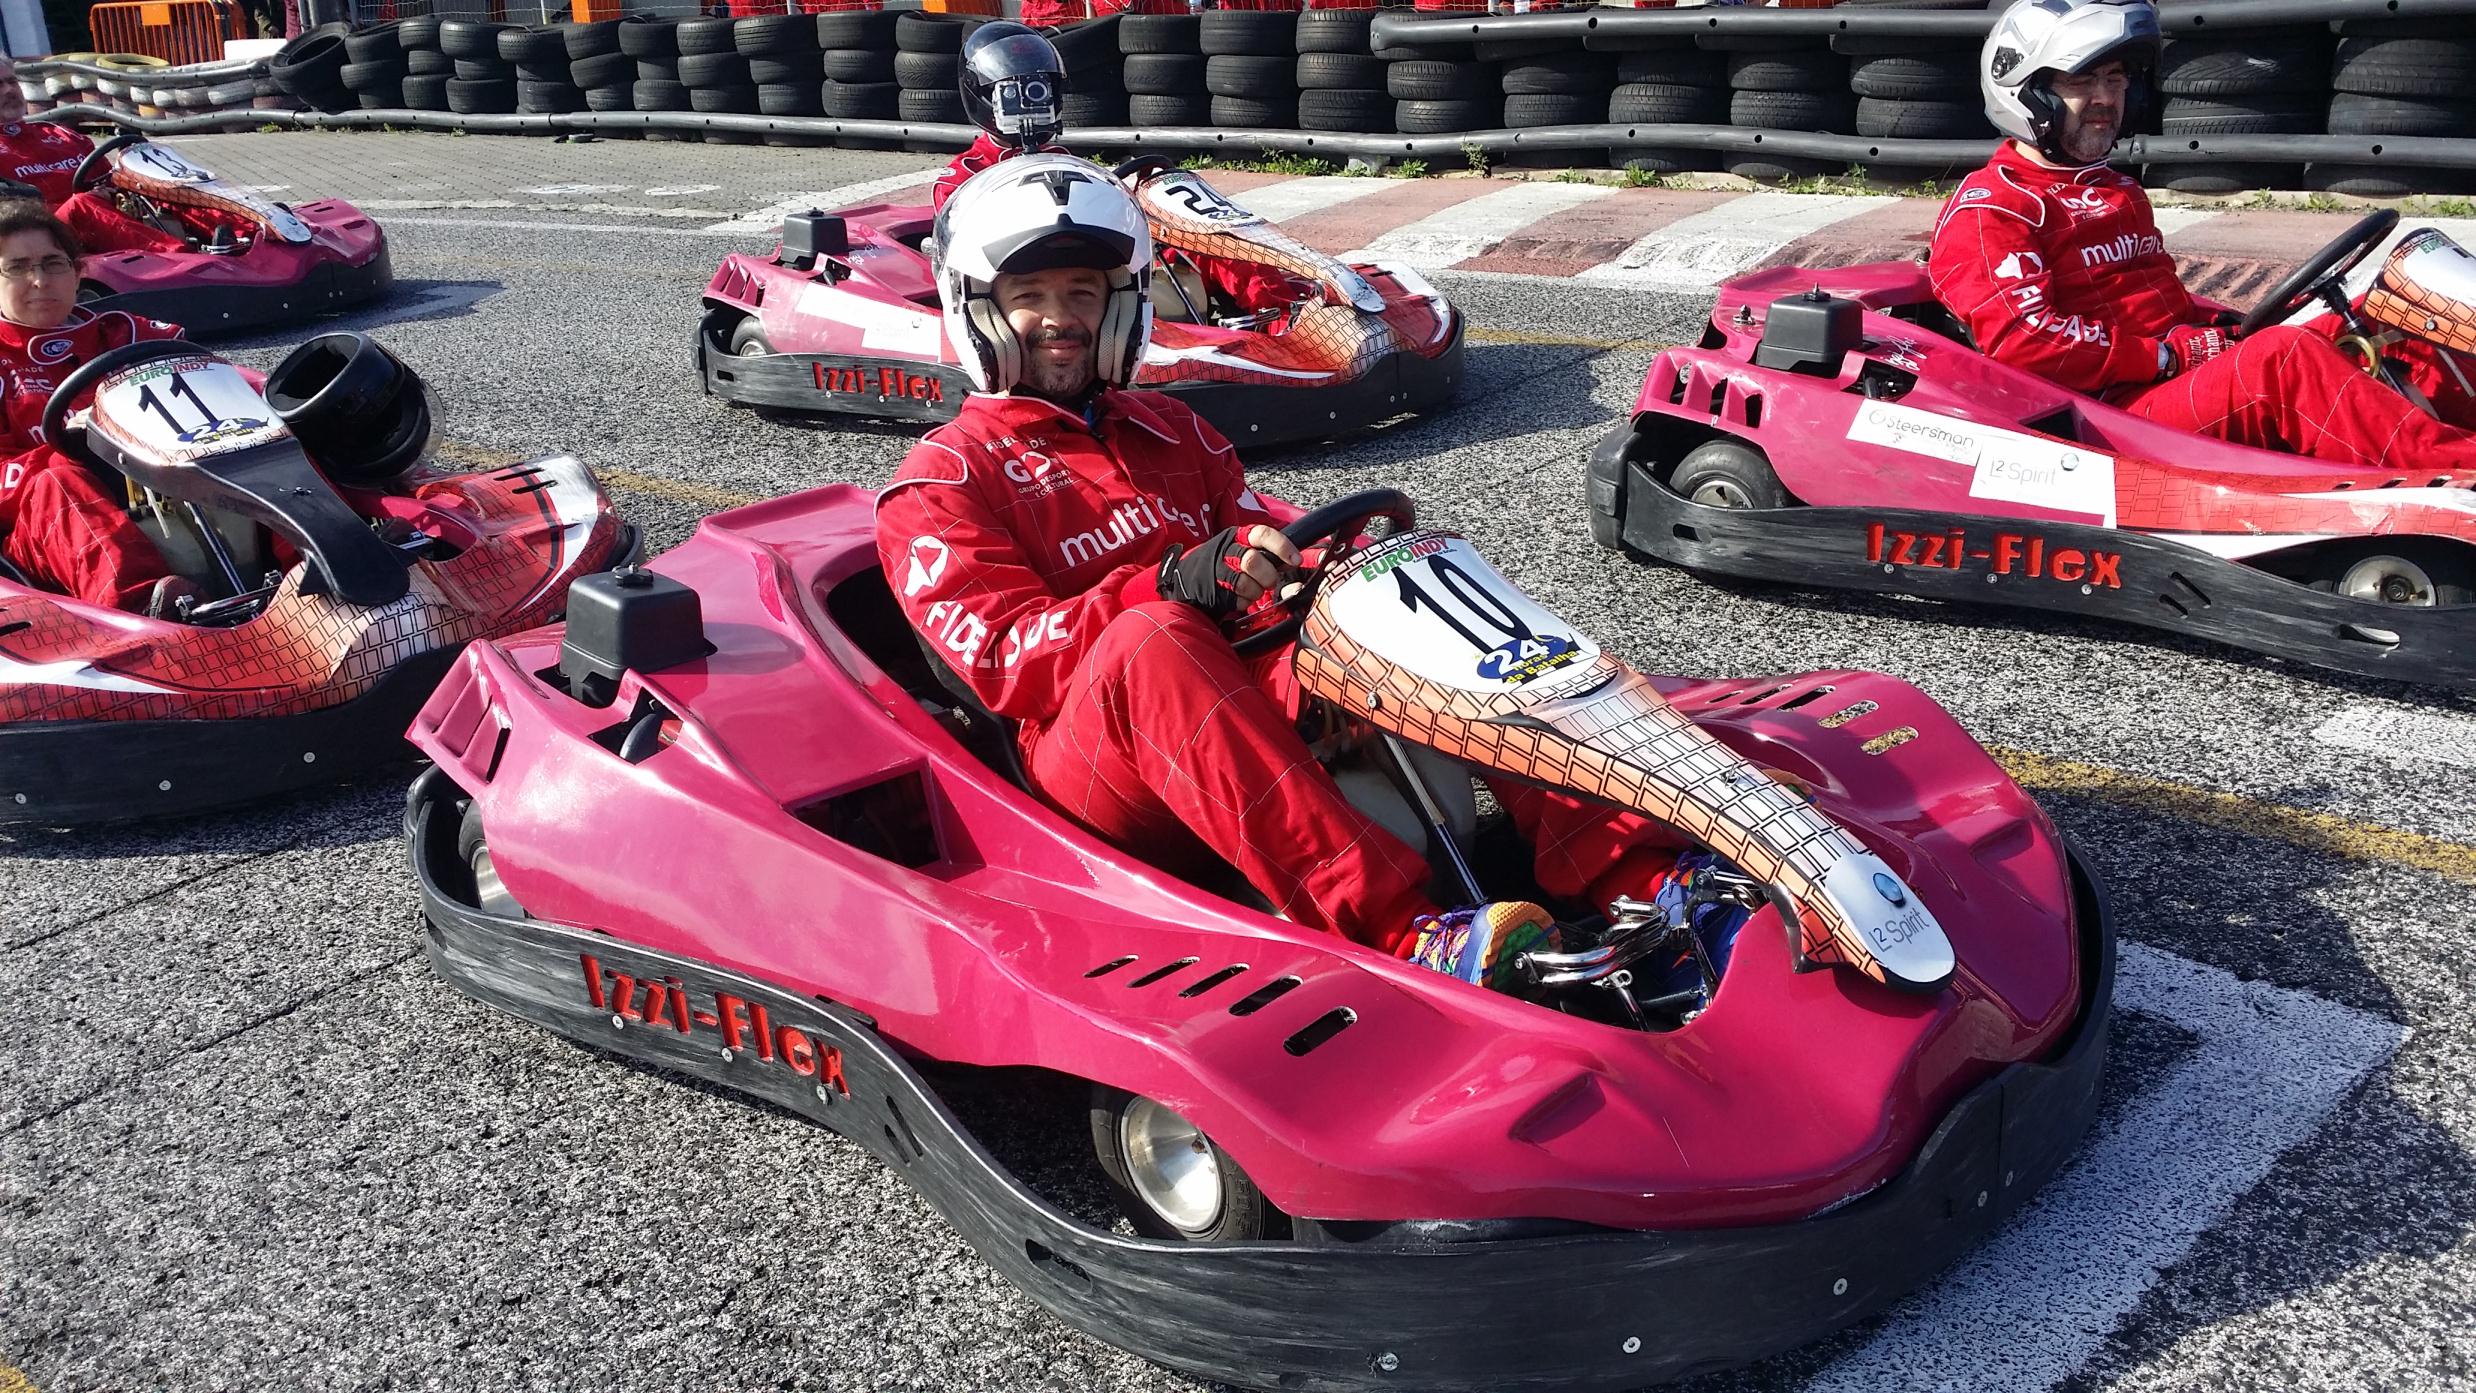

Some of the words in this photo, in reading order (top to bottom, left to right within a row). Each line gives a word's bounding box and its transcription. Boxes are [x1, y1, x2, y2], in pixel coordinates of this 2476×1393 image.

[129, 360, 209, 387] EUROINDY
[812, 361, 943, 403] Izzi-Flex
[138, 372, 218, 434] 11
[1886, 414, 1974, 448] Steersman
[2007, 462, 2057, 485] Spirit
[1361, 538, 1449, 582] EUROINDY
[1867, 522, 2121, 589] Izzi-Flex
[1391, 555, 1533, 655] 10
[1483, 639, 1550, 676] 24
[1506, 673, 1526, 684] da
[1525, 650, 1578, 676] Batalha
[1885, 907, 1930, 945] Spirit
[580, 953, 851, 1100] Izzi-Flex
